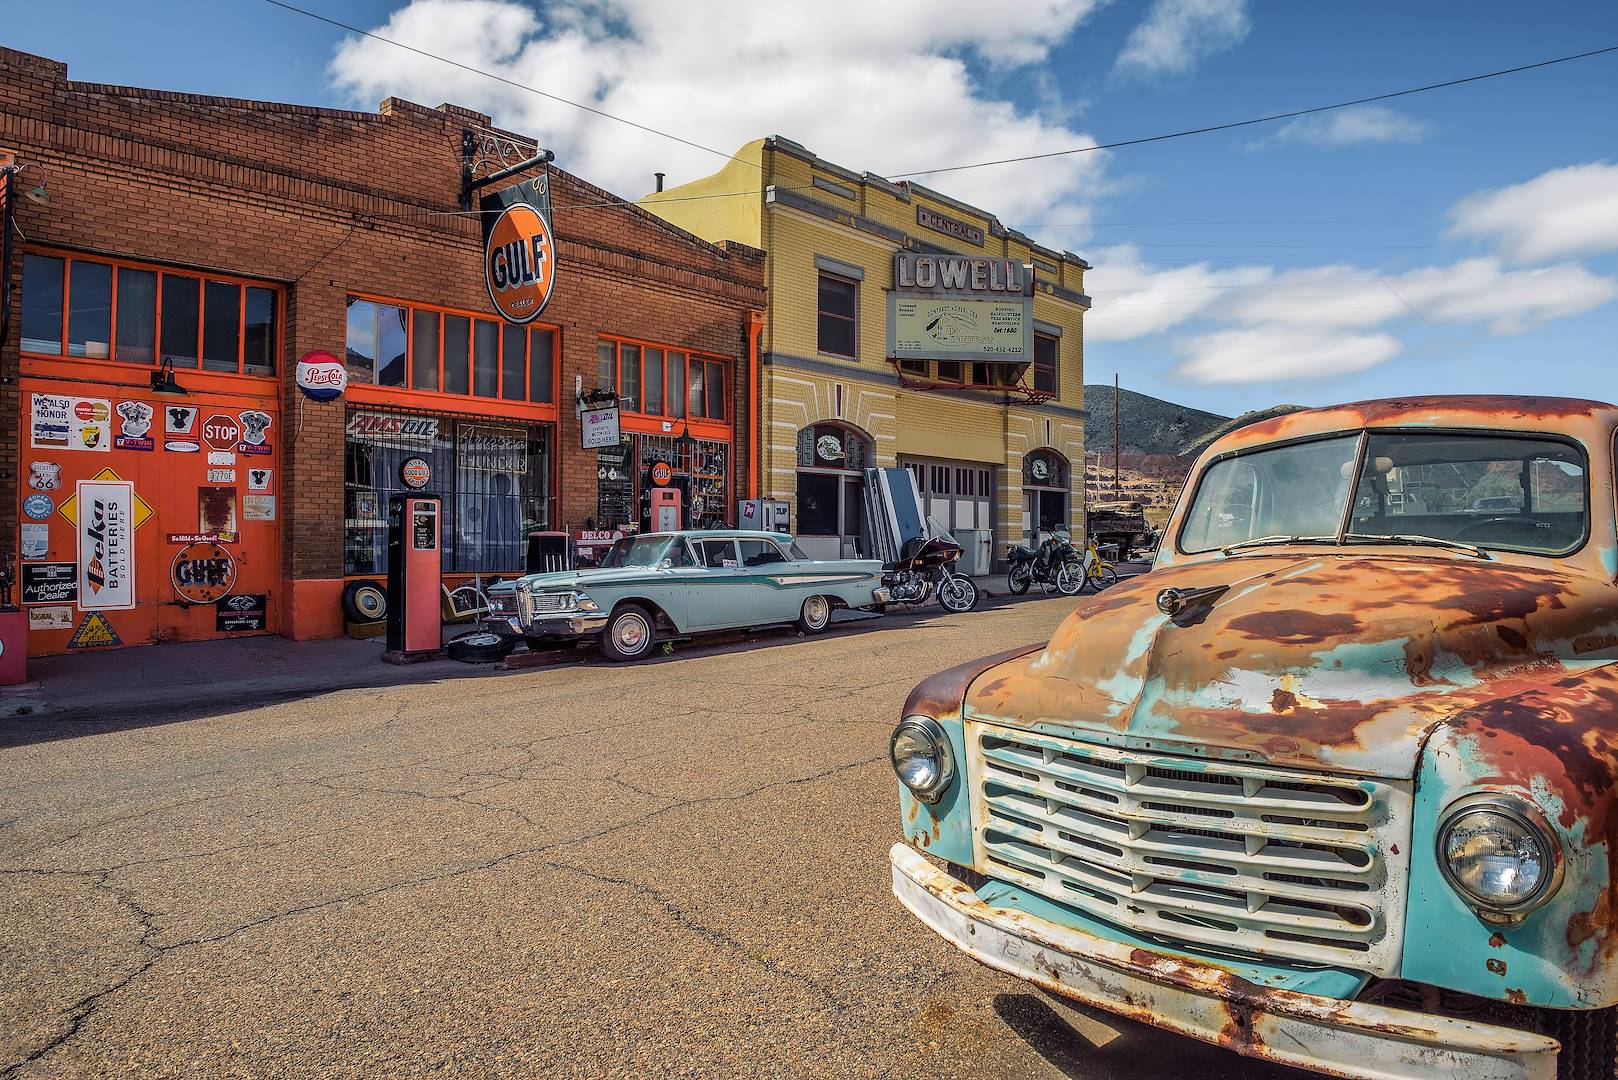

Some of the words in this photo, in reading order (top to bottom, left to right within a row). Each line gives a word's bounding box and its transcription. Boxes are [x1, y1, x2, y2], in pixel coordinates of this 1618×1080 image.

[930, 215, 972, 238] CENTRAL
[491, 234, 547, 292] GULF
[899, 257, 1022, 292] LOWELL
[33, 397, 50, 406] WE
[49, 400, 70, 409] ALSO
[37, 409, 67, 419] HONOR
[349, 414, 438, 435] AMSOIL
[205, 424, 237, 440] STOP
[588, 437, 601, 445] SOLD
[602, 435, 616, 443] HERE
[34, 464, 56, 472] ROUTE
[459, 455, 526, 471] THUNDER
[654, 468, 671, 480] GULF
[36, 478, 54, 489] 66
[28, 494, 48, 502] SUPER
[581, 530, 611, 540] DELCO
[108, 502, 118, 589] BATTERIES
[37, 590, 69, 600] Dealer
